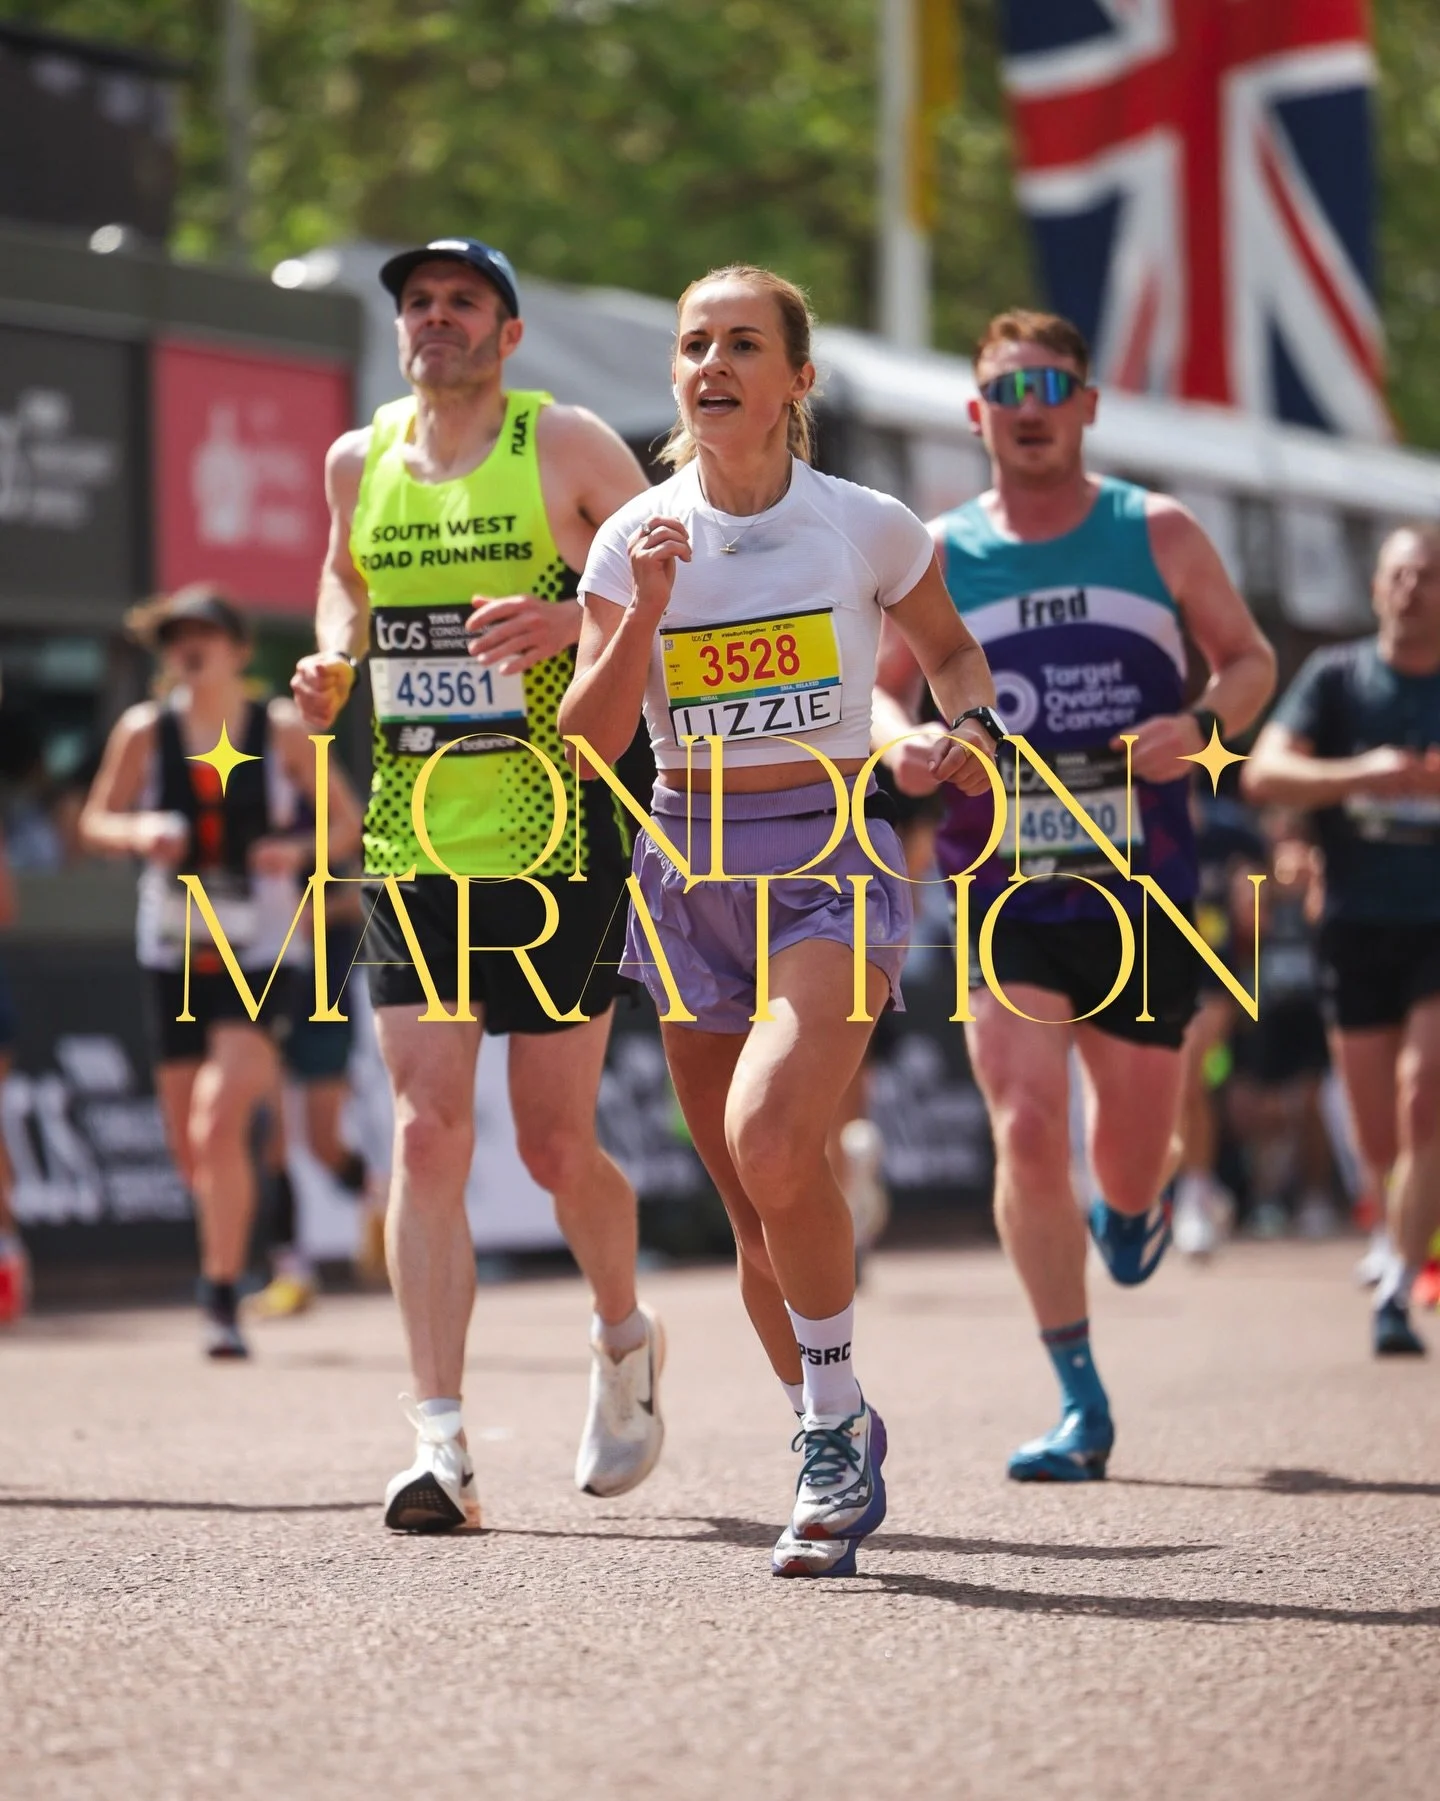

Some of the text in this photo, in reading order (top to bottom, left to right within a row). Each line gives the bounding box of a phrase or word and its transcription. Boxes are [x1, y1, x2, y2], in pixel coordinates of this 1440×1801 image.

[372, 515, 517, 543] SOUTH WEST
[420, 542, 533, 568] RUNNERS
[1018, 586, 1088, 629] Fred
[376, 614, 427, 651] tcs
[699, 634, 800, 687] 3528
[1042, 660, 1123, 691] Target
[397, 670, 494, 708] 43561
[1044, 684, 1143, 711] Ovarian
[683, 691, 831, 743] LIZZIE
[1047, 706, 1136, 732] Cancer
